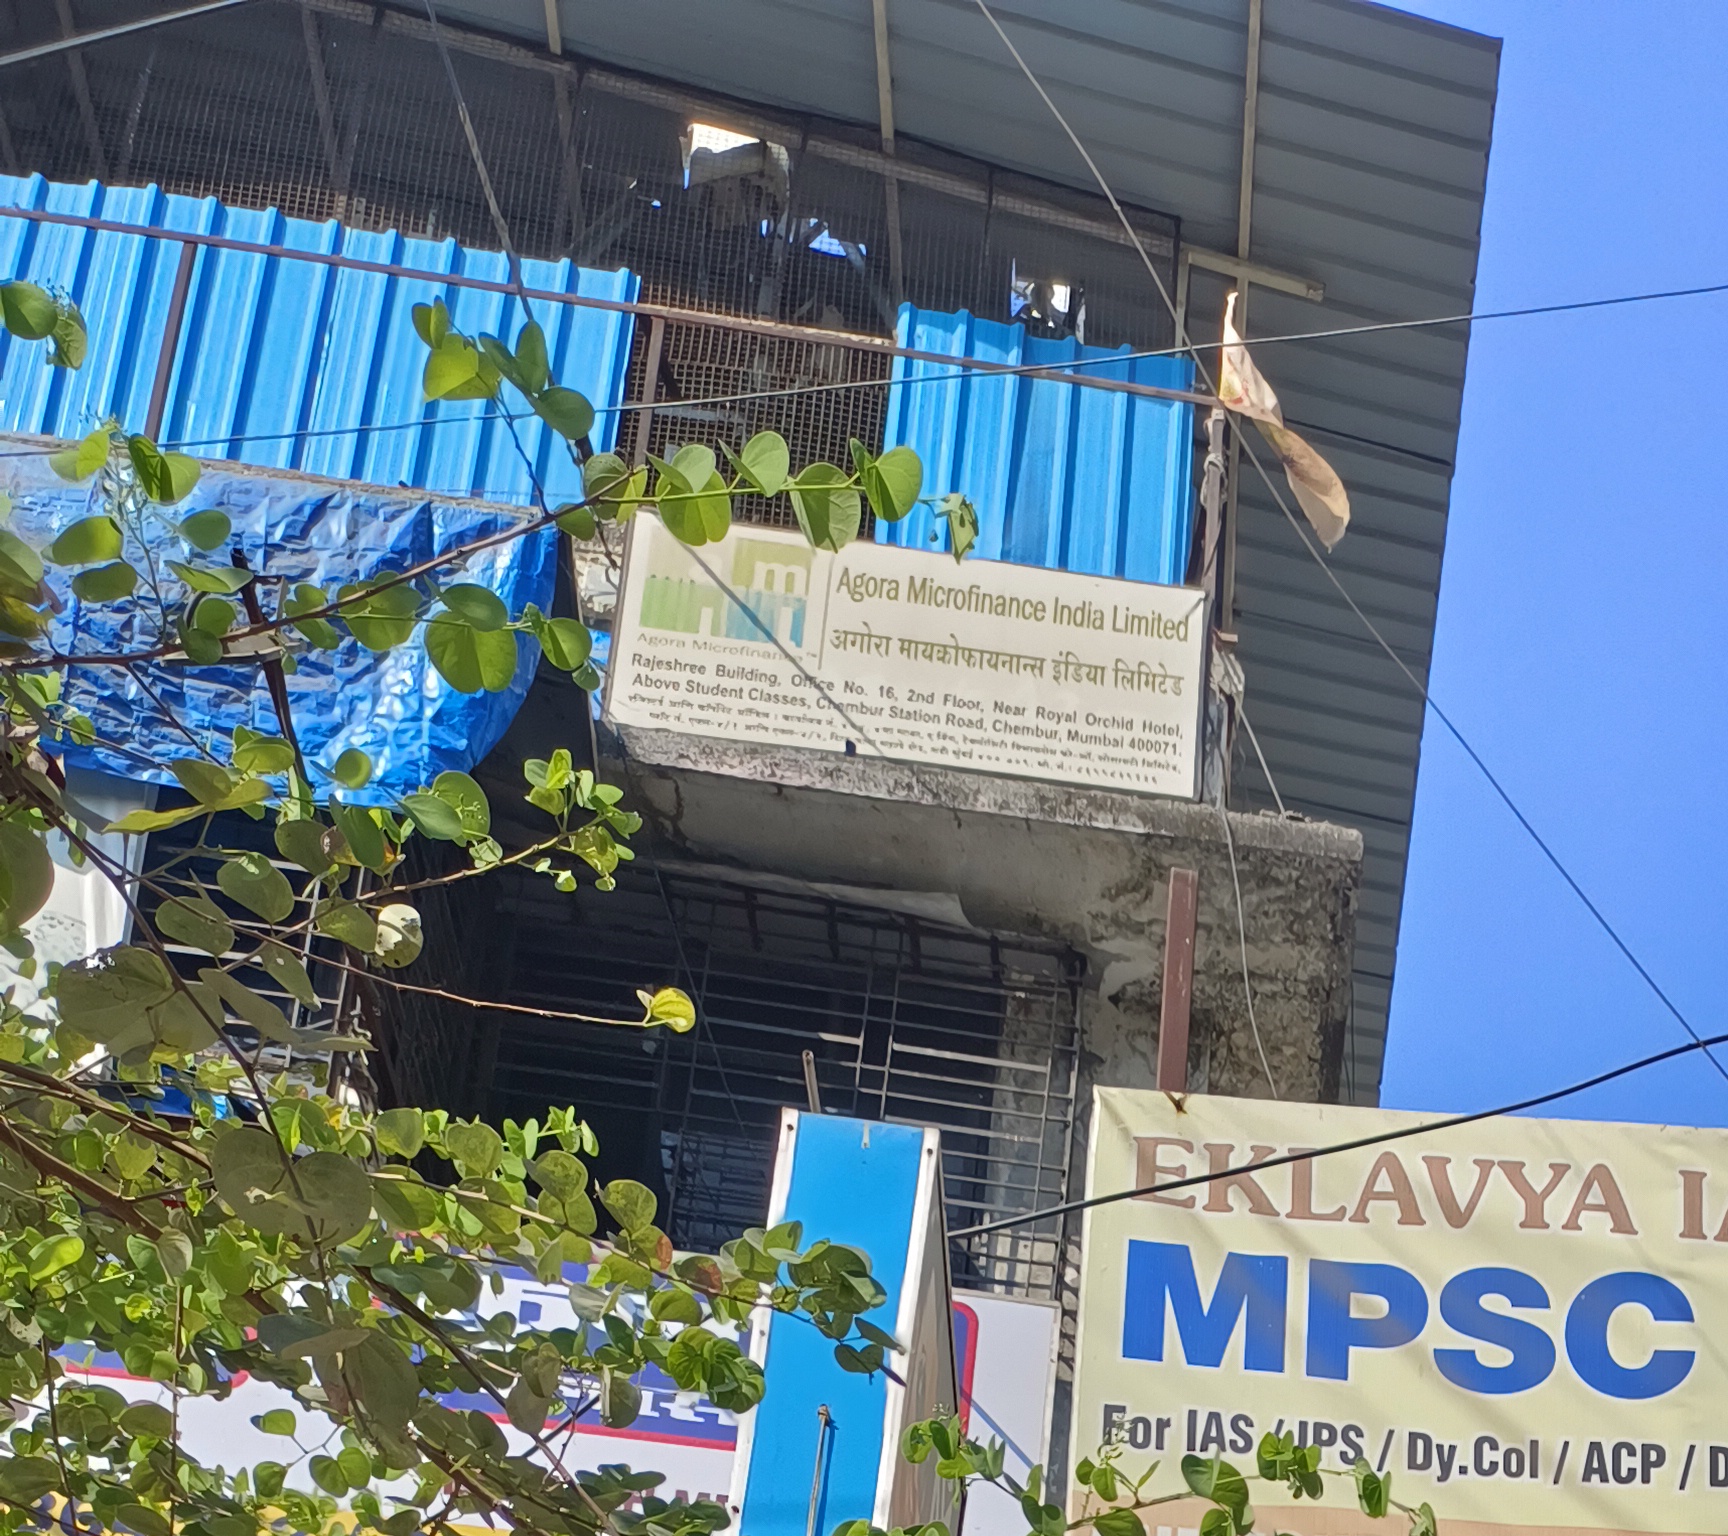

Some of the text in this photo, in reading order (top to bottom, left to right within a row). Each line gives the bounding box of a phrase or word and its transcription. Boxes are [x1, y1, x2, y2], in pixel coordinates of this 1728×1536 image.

[836, 566, 1189, 643] Agora Microfinance India Limited
[632, 653, 1133, 731] Rajeshree Building, Royal Orchid
[831, 621, 891, 659] अगोरा
[1053, 653, 1104, 686] इंडिया
[1113, 661, 1184, 698] लिमिटेड
[686, 681, 1123, 748] Student Mumbai
[1129, 1134, 1638, 1237] EKLAVYA
[1121, 1238, 1696, 1400] MPSC
[1102, 1404, 1171, 1450] For
[1187, 1409, 1254, 1454] IAS
[1407, 1433, 1538, 1483] Dy.Col
[1582, 1441, 1666, 1485] ACP
